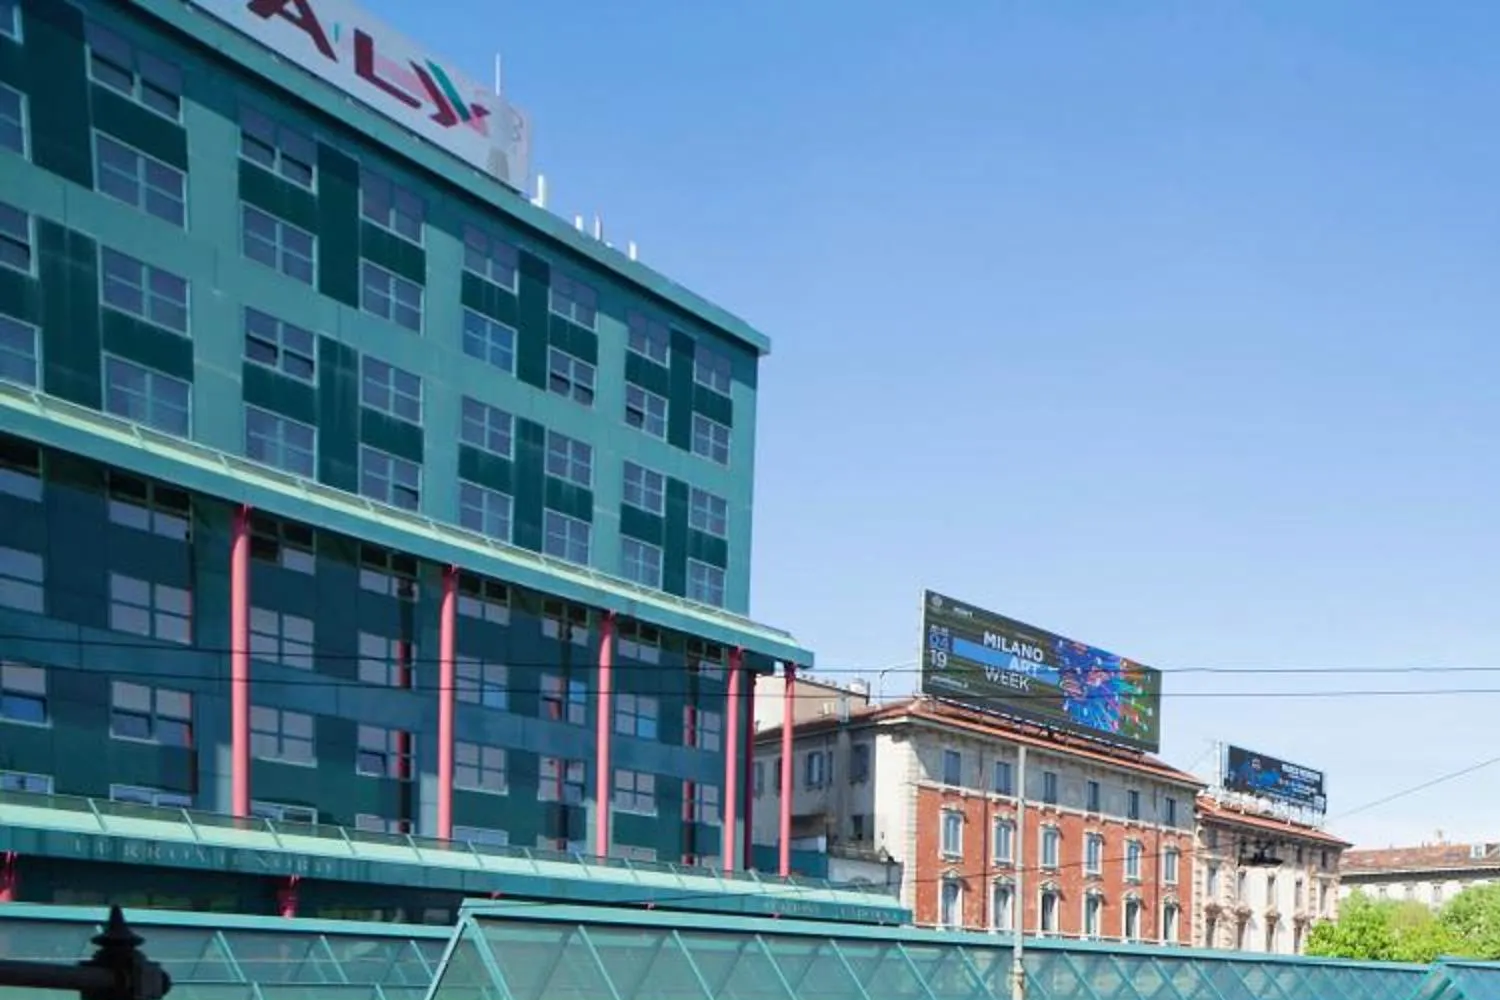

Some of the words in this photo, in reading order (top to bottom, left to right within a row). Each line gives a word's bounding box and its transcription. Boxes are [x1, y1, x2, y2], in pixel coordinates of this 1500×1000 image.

[930, 649, 947, 668] 19
[983, 630, 1043, 662] MILANO
[984, 664, 1030, 692] WEEK
[1009, 655, 1038, 678] ART
